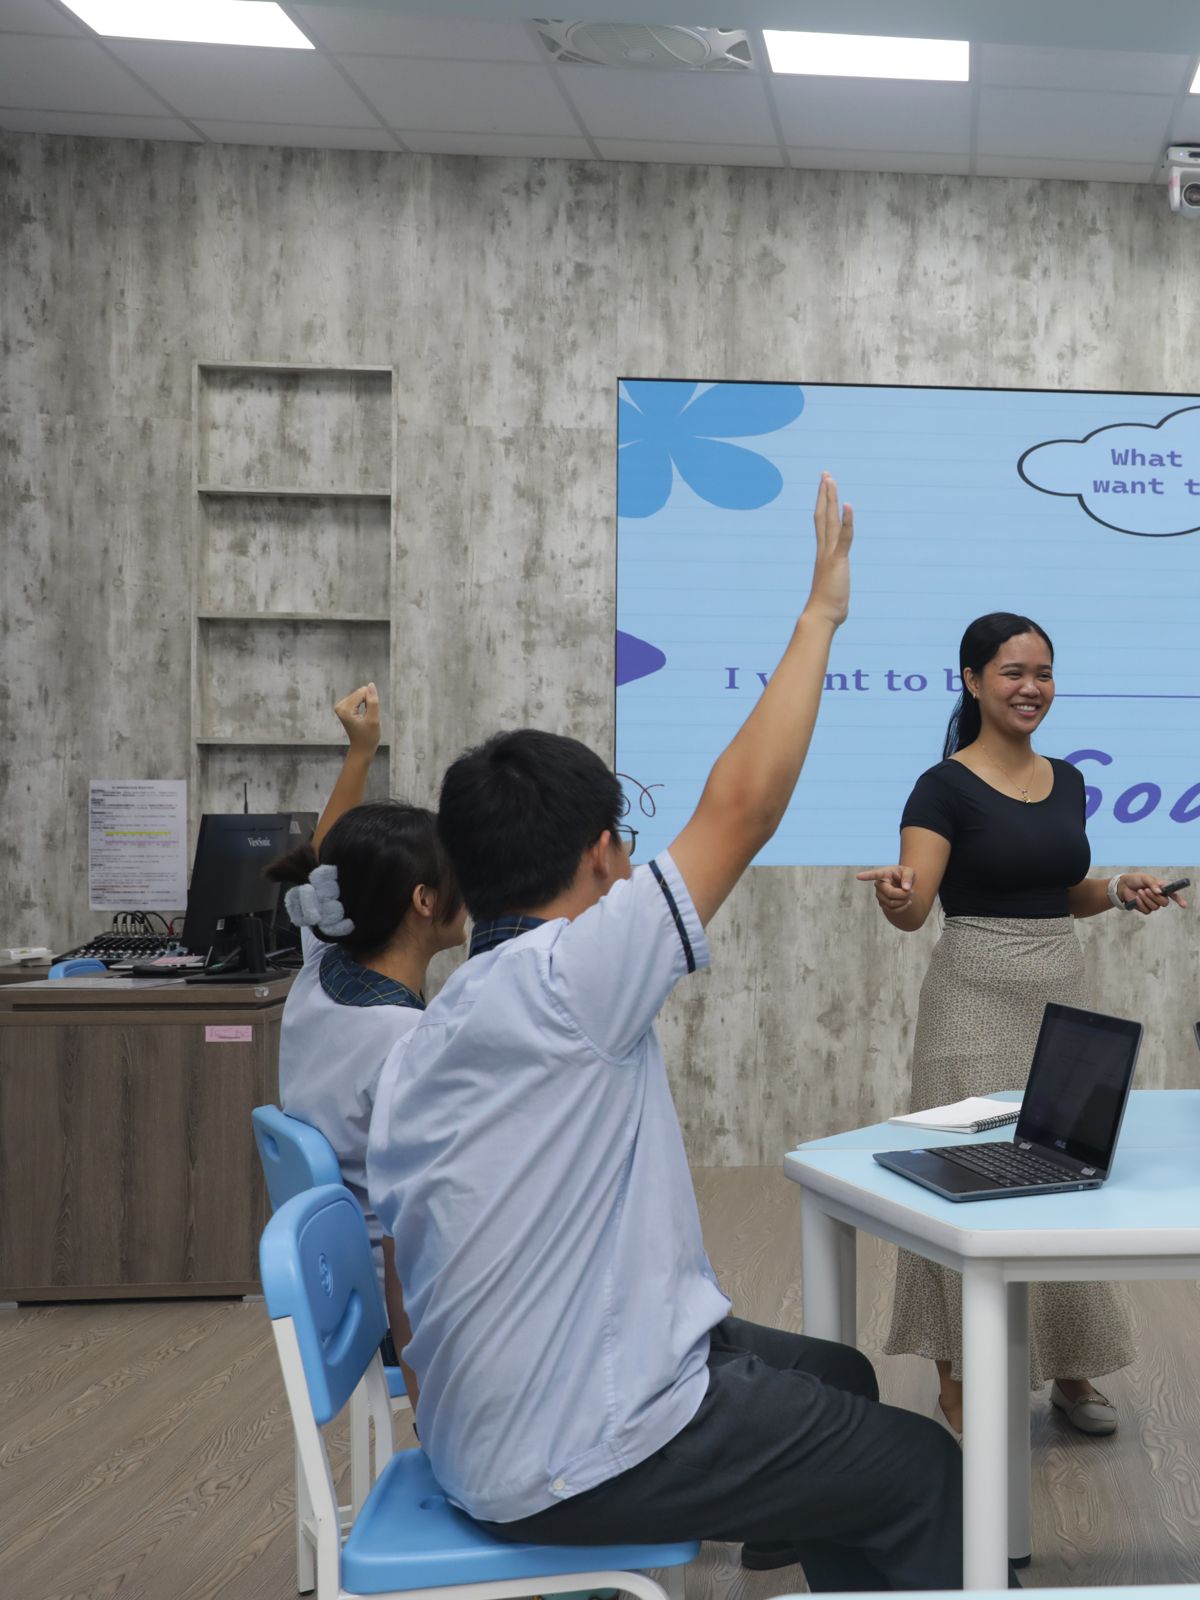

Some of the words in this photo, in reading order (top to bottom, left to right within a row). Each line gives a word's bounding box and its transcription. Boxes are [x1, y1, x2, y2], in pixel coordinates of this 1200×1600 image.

[1111, 448, 1183, 467] What
[1092, 478, 1165, 495] want
[725, 667, 740, 690] I
[884, 669, 928, 691] to
